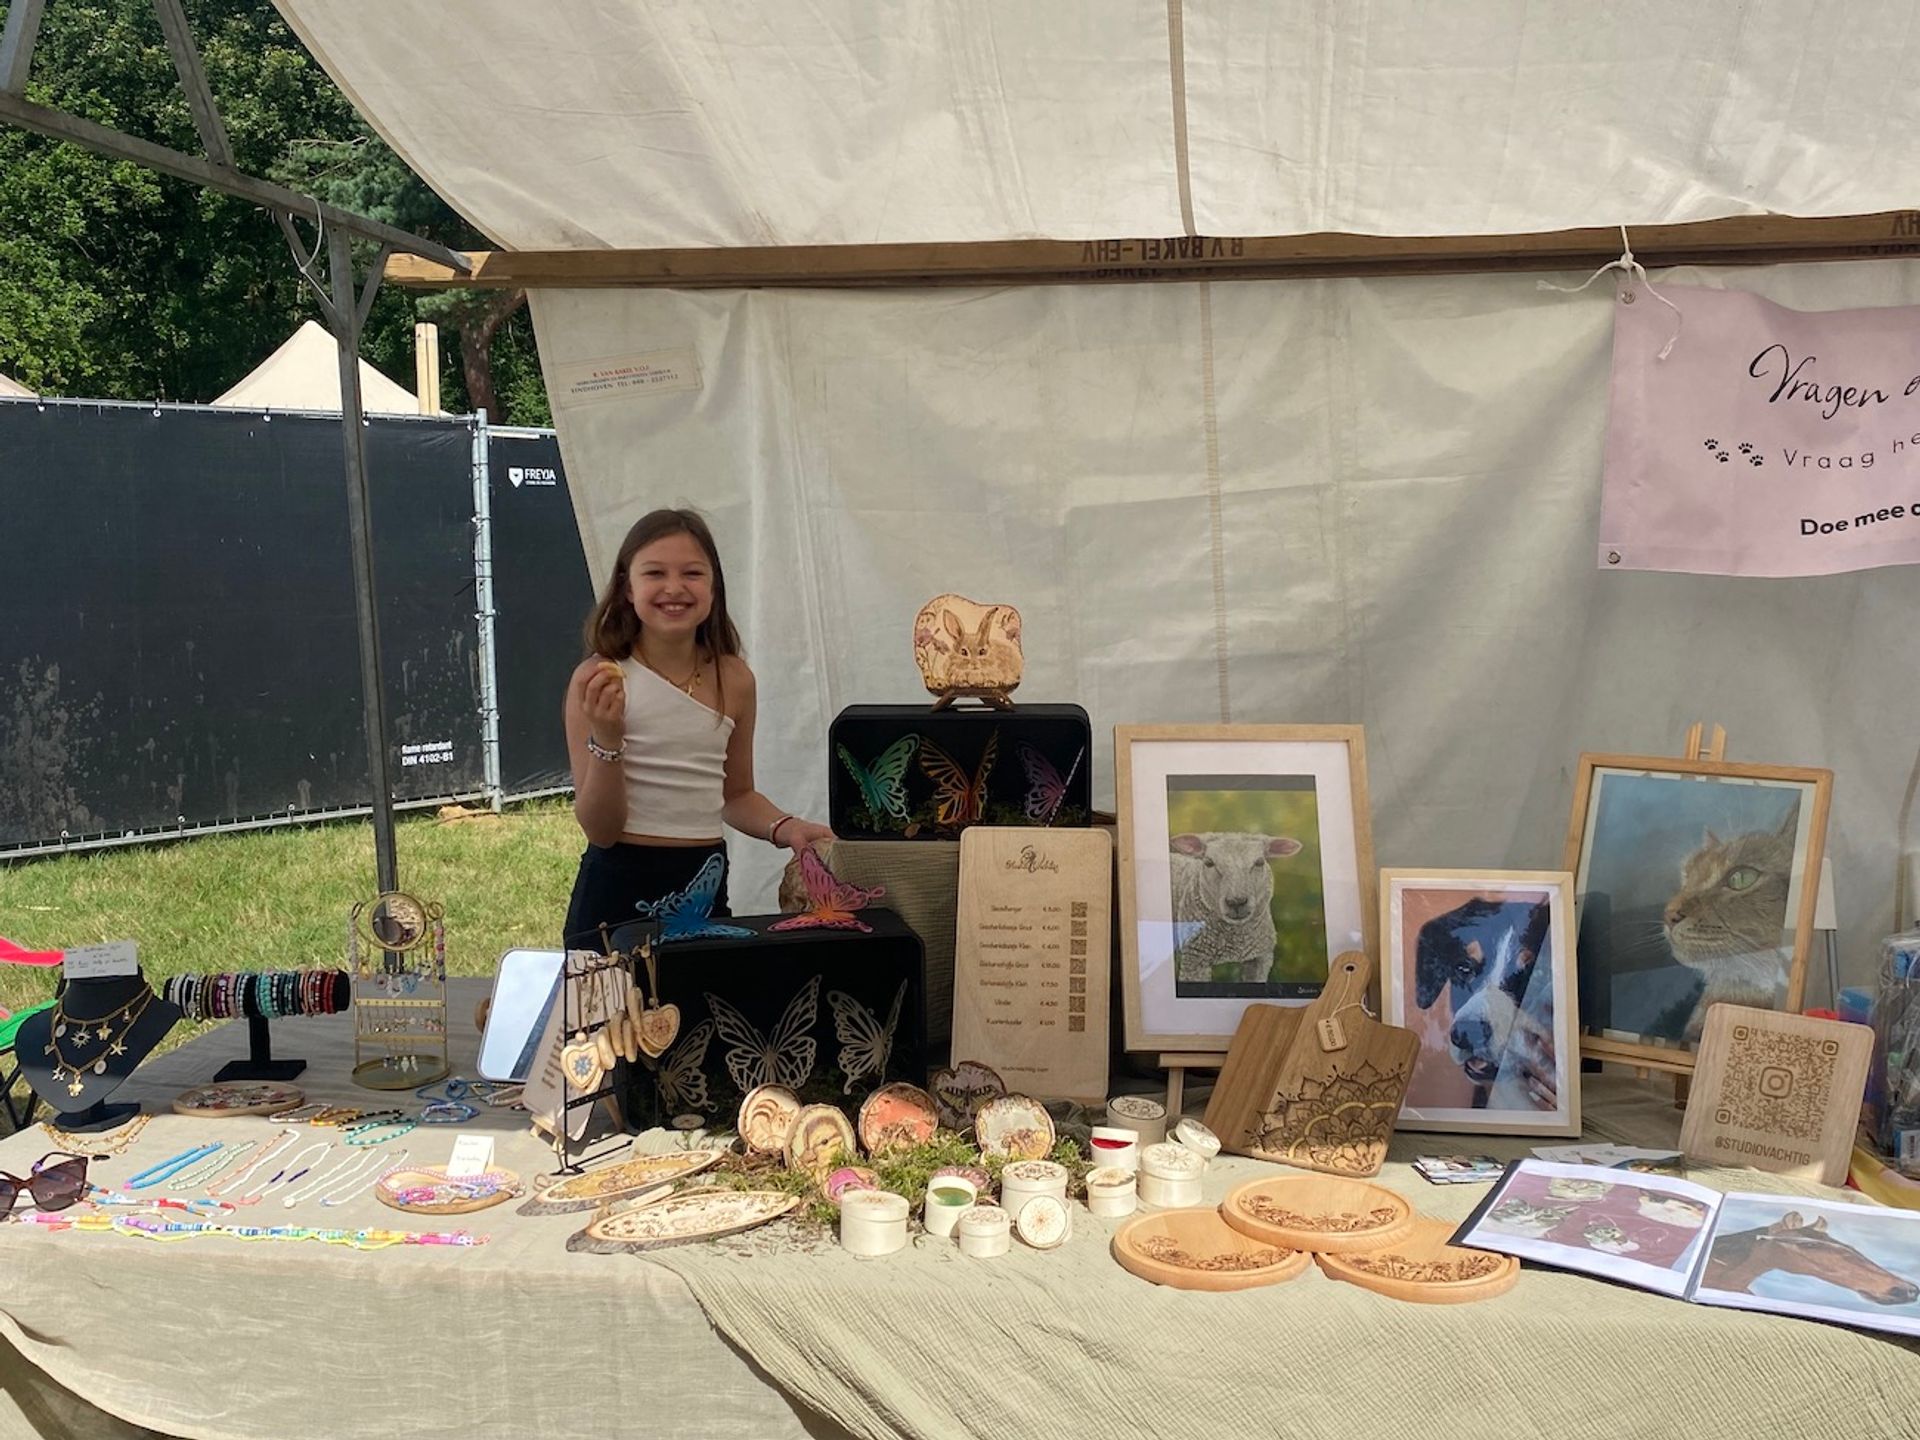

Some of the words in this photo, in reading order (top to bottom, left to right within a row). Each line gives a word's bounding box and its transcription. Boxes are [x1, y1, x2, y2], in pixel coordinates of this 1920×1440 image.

[571, 383, 614, 395] EINDHOVEN
[1749, 344, 1889, 420] Vragen
[1783, 448, 1875, 470] Vraag
[1801, 518, 1849, 536] Doe
[1854, 505, 1905, 528] mee
[401, 755, 418, 767] DIN
[1714, 1135, 1811, 1166] @STUDIOVACHTIG
